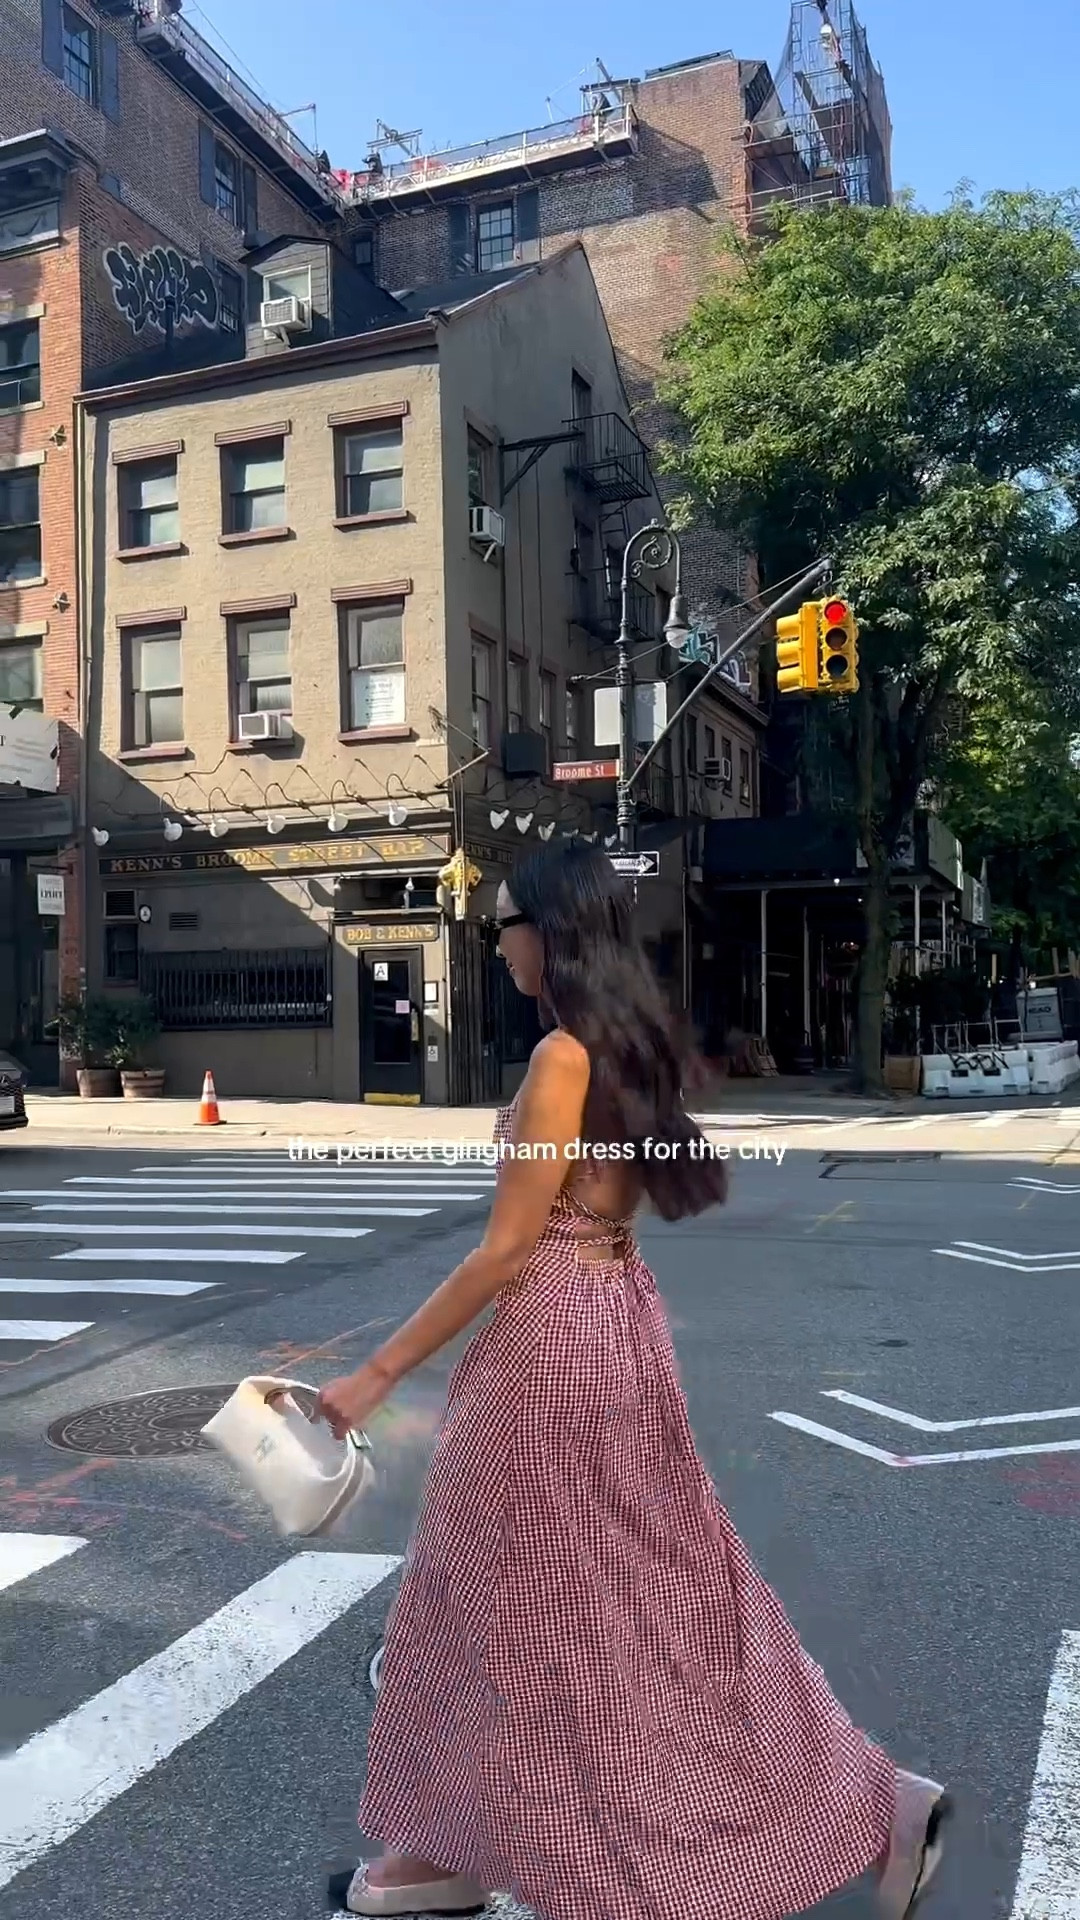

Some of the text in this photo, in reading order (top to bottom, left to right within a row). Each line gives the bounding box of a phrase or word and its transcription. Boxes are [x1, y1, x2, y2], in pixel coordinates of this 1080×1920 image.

[555, 764, 605, 780] Broome St
[110, 856, 182, 873] KENN'S
[196, 850, 275, 868] BROOME
[288, 845, 365, 862] STREET
[346, 927, 372, 941] BOB
[376, 927, 385, 940] &
[376, 965, 386, 977] A
